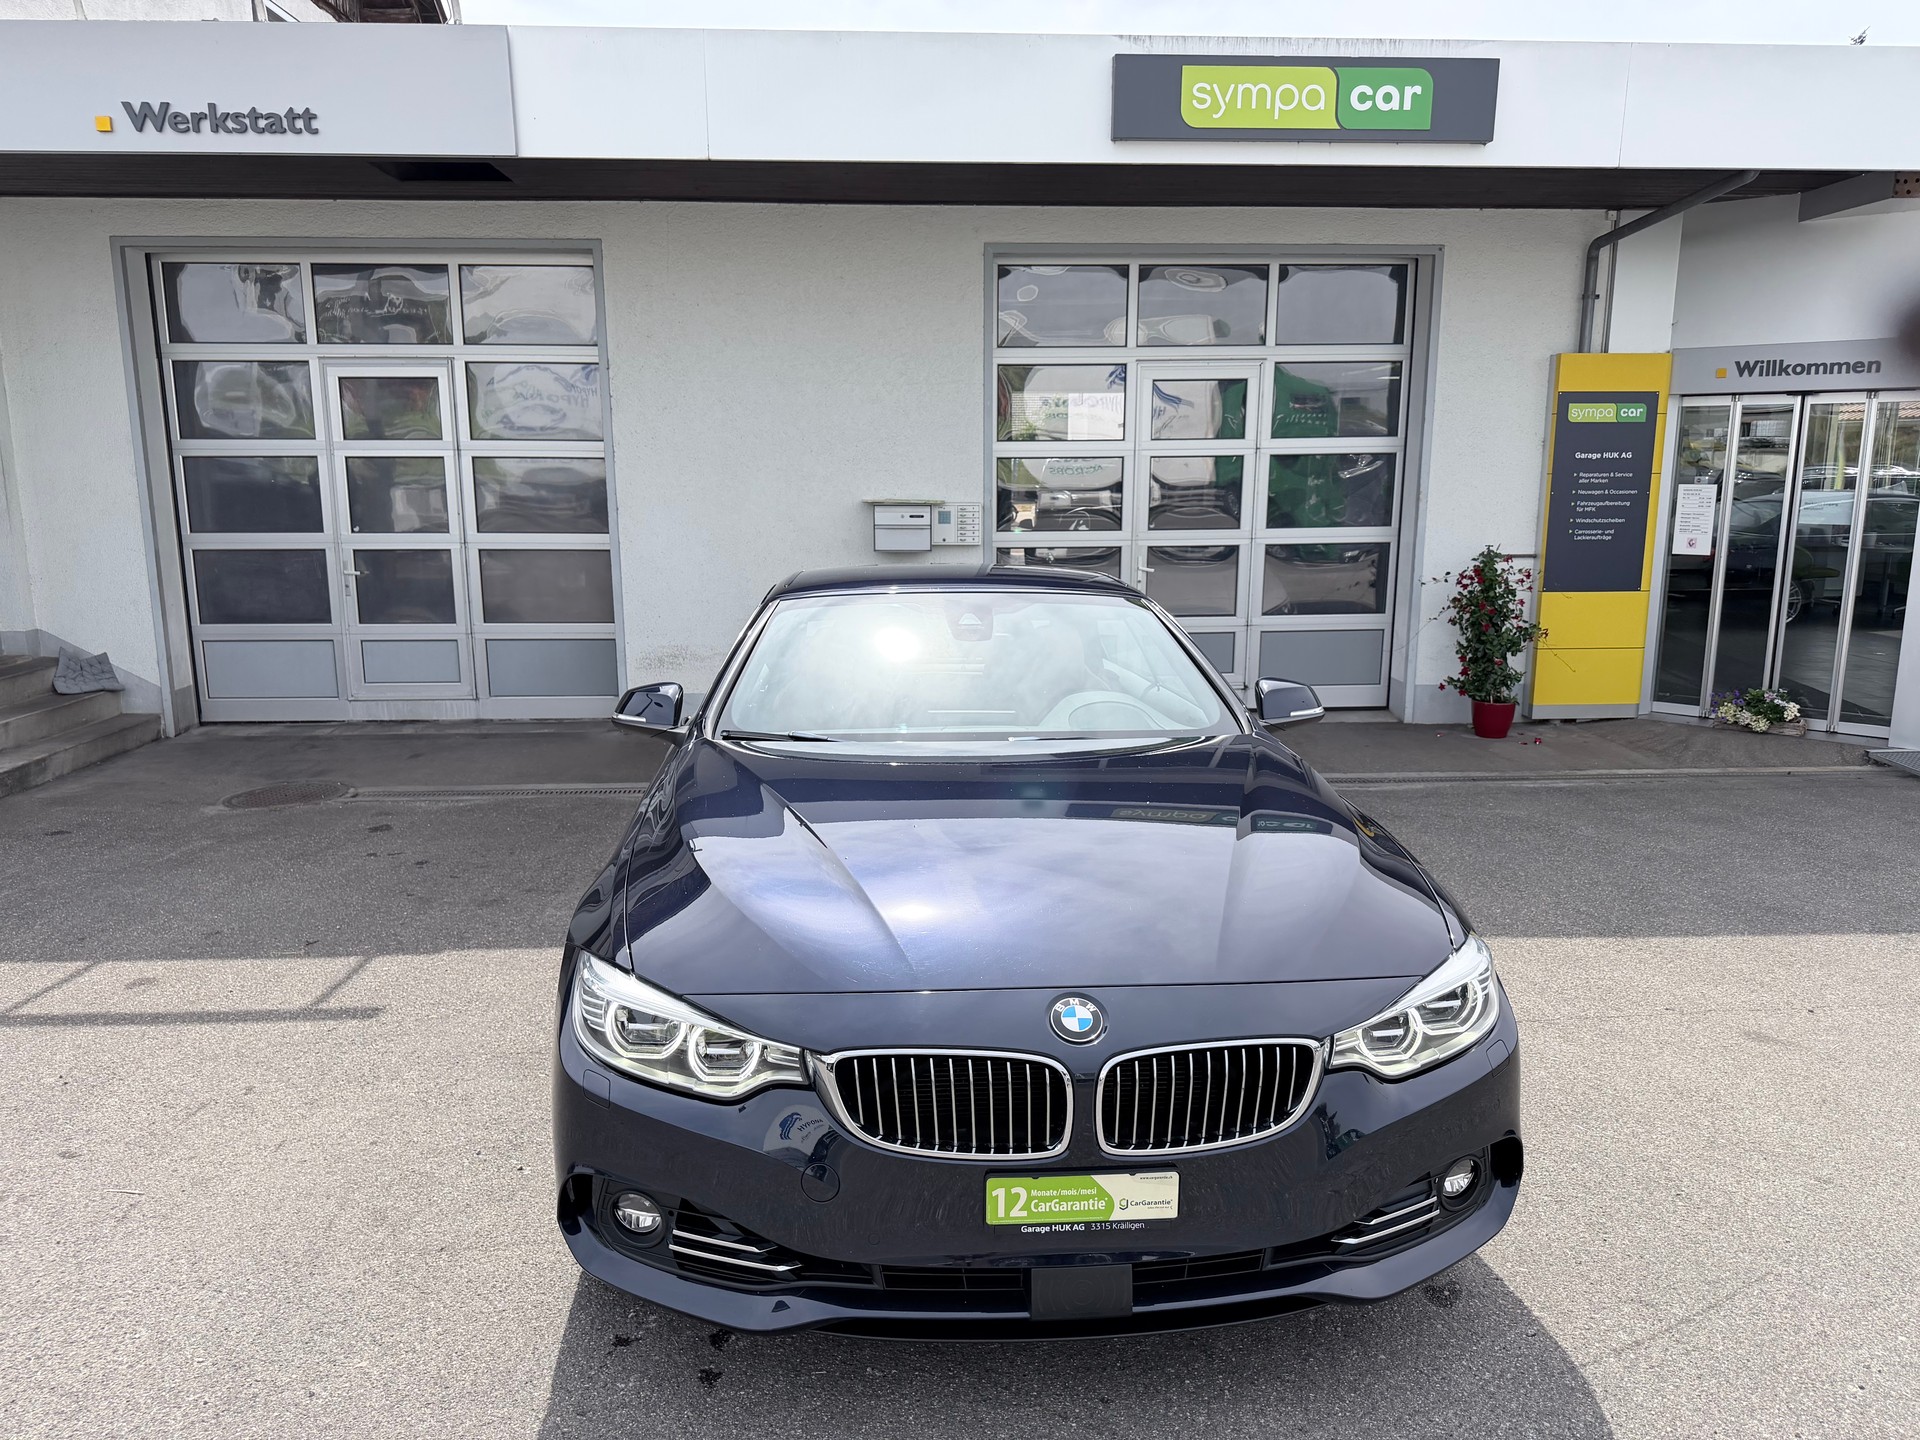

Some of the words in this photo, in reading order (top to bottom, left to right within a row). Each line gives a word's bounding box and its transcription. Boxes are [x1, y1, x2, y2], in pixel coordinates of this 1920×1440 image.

[1191, 82, 1326, 119] sympa
[1349, 83, 1422, 111] car
[121, 101, 319, 135] Werkstatt
[1734, 358, 1882, 378] Willkommen
[1571, 406, 1614, 420] sympa
[1620, 406, 1644, 418] car
[1575, 452, 1602, 460] Garage
[1055, 998, 1097, 1012] BMW
[992, 1187, 1028, 1218] 12
[1031, 1187, 1097, 1197] Monate/mois/mesi
[1021, 1225, 1050, 1234] Garage
[1052, 1224, 1071, 1232] HUK
[1072, 1223, 1085, 1231] AG
[1090, 1222, 1111, 1231] 3315
[1112, 1222, 1145, 1231] Kräiligen
